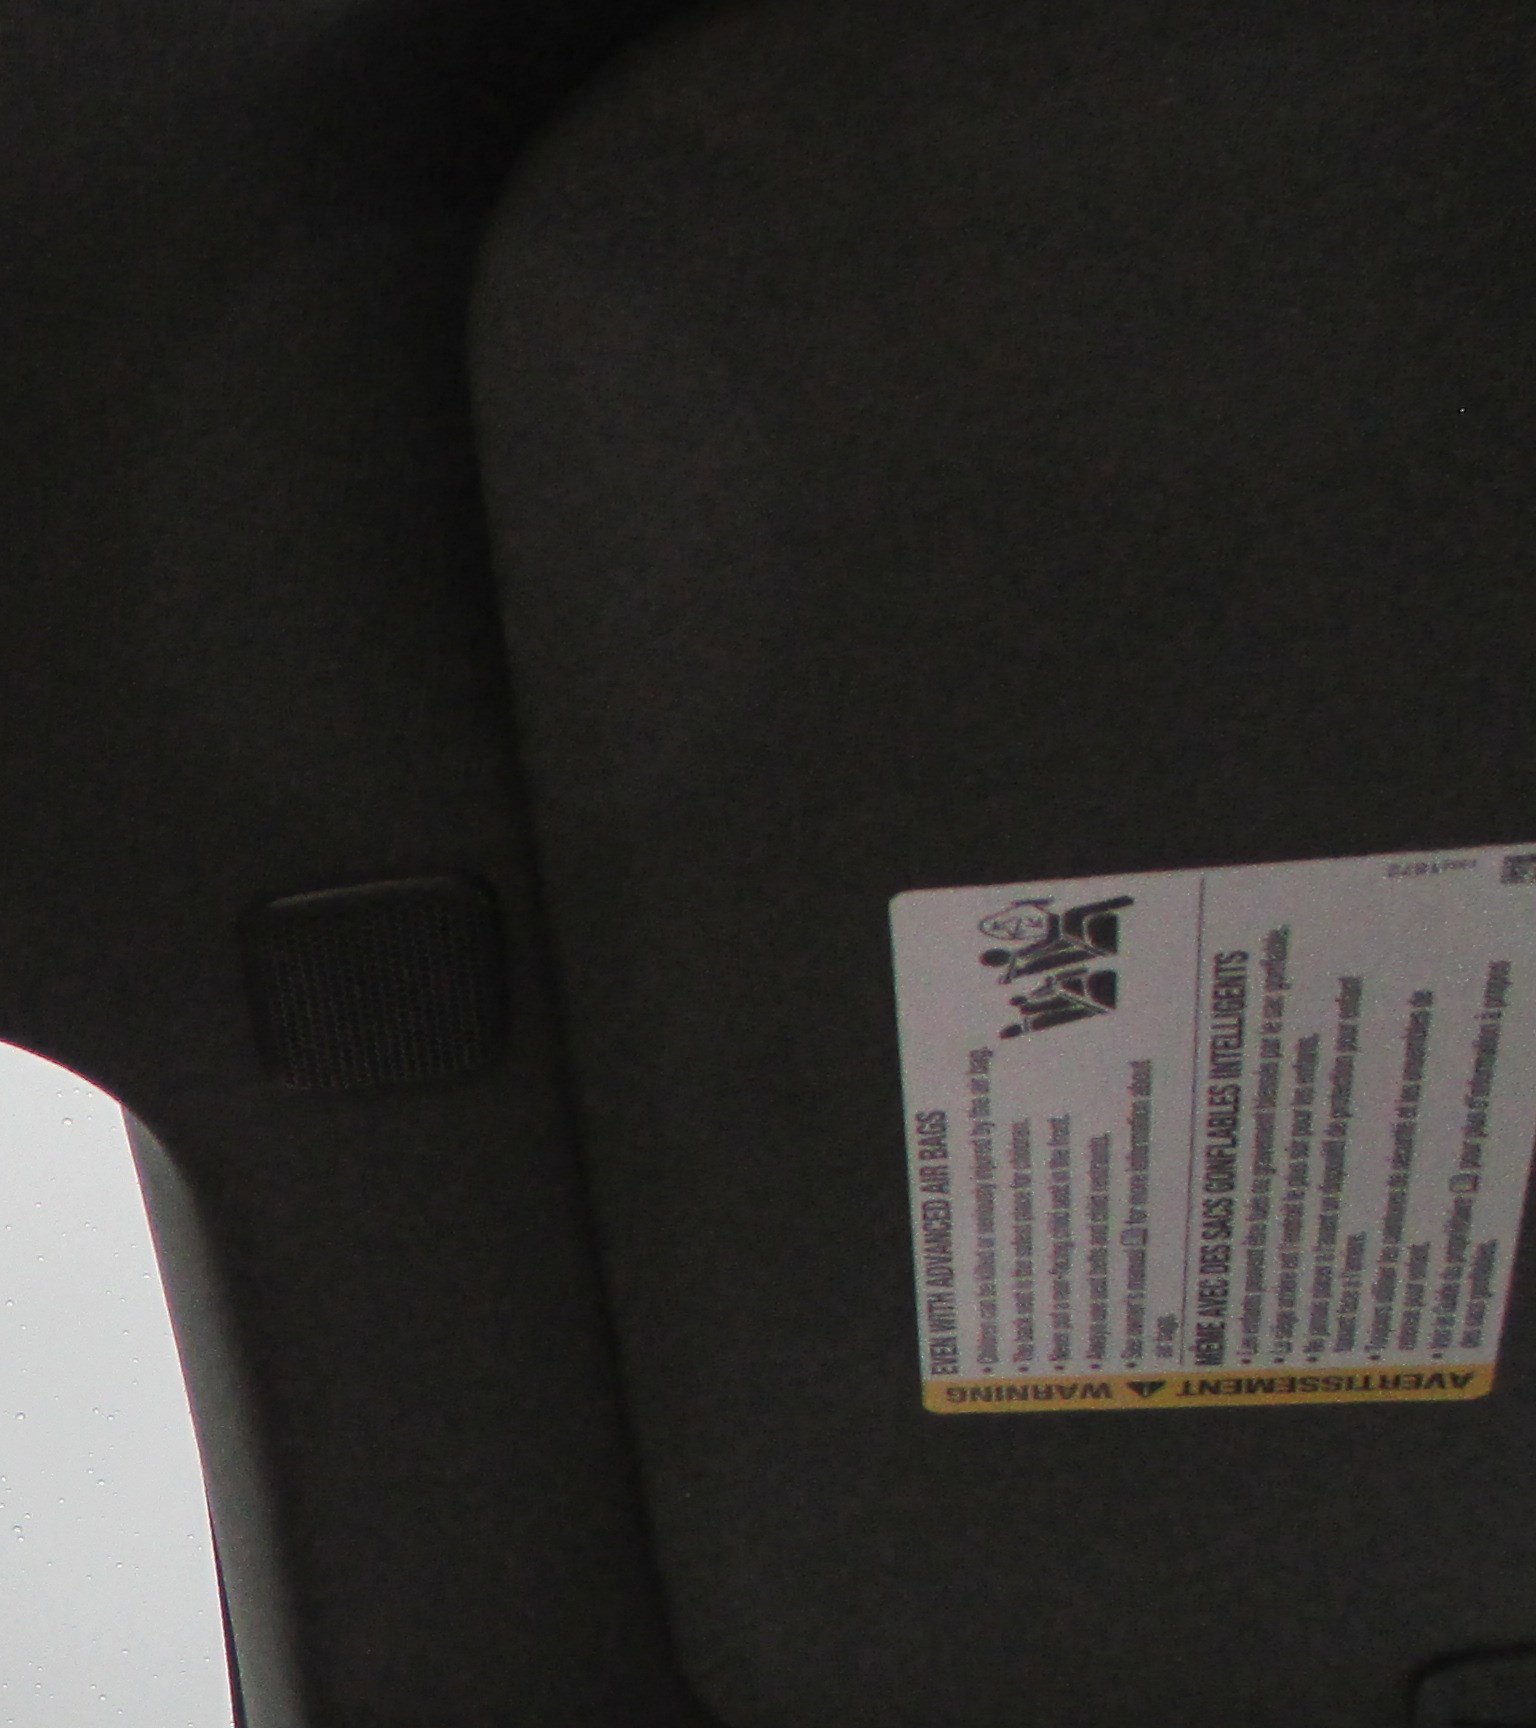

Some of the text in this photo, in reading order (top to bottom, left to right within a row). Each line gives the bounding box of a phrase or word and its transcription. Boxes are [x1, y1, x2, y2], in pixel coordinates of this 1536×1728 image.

[915, 1109, 958, 1376] EVEN WITH ADVANCED AIR BAGS
[1187, 948, 1248, 1366] MÊME AVEC DES SACS GONFLABLES INTELLIGENTS
[946, 1372, 1473, 1401] AVERTISSEMENT WARNING
